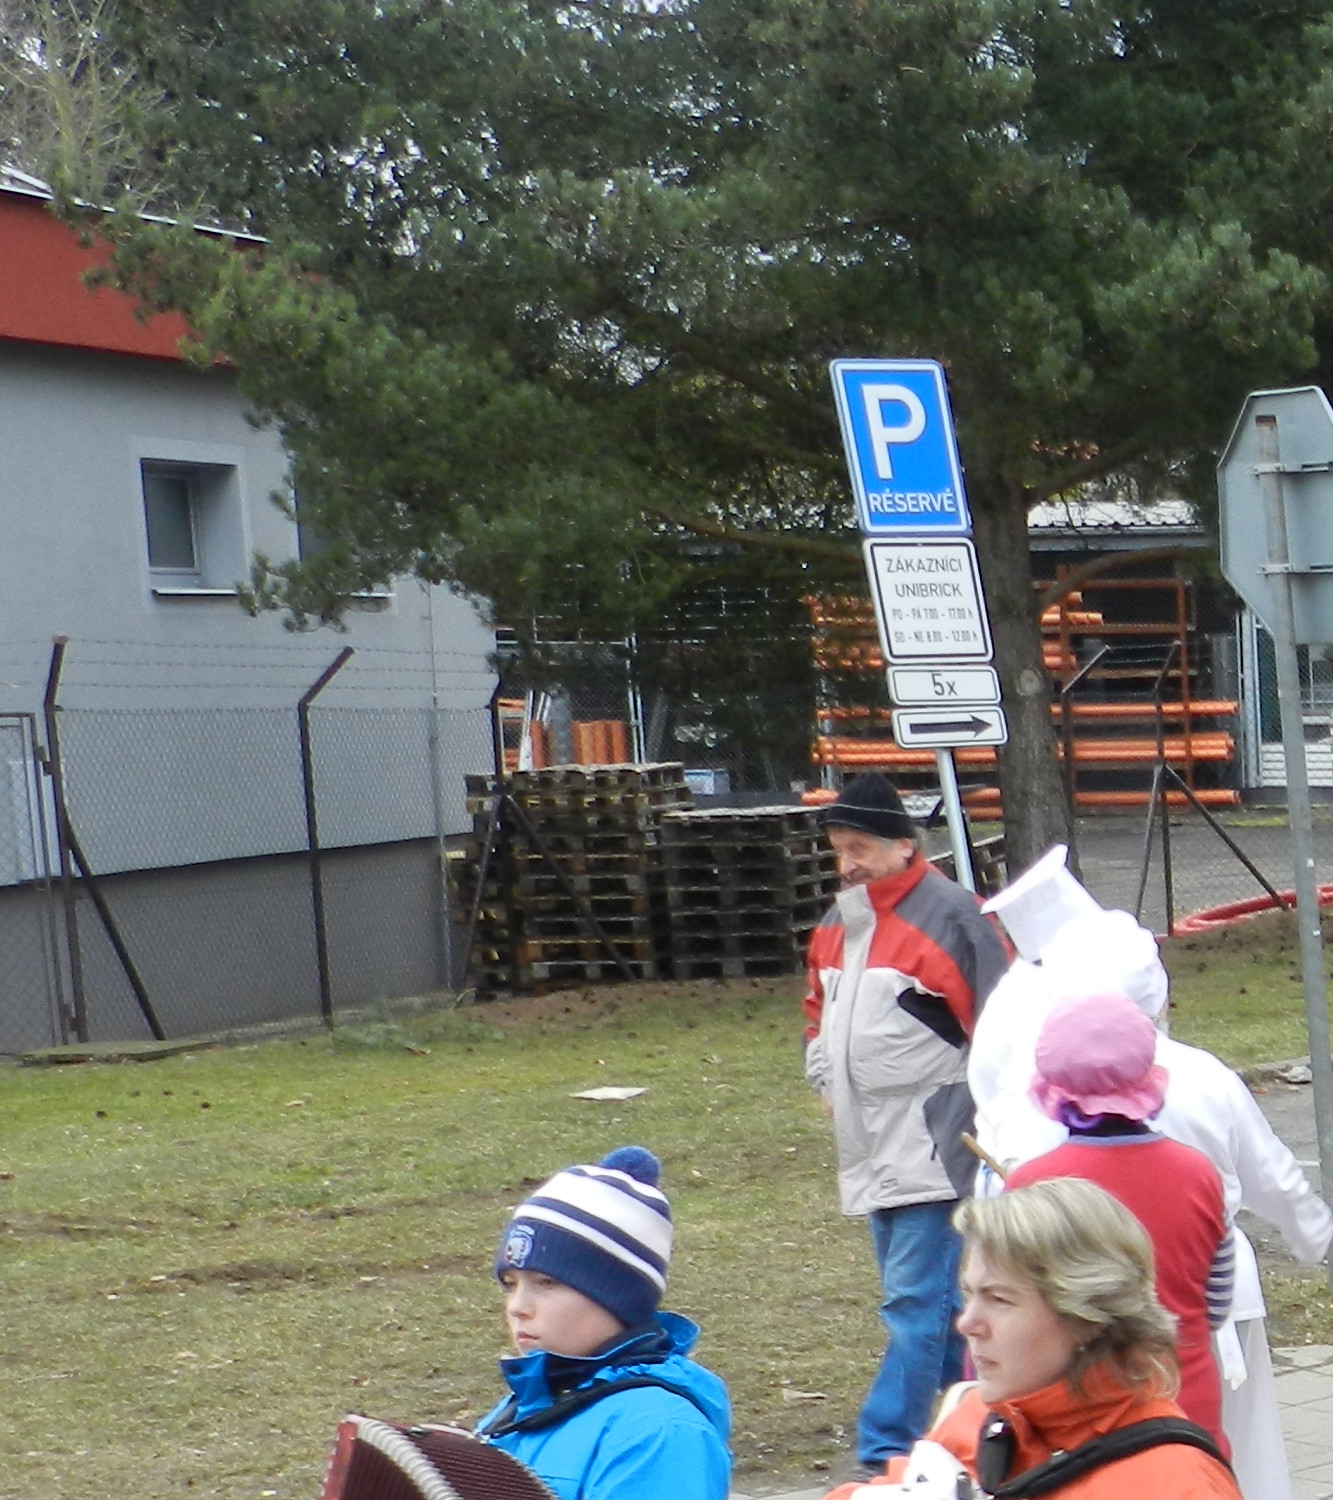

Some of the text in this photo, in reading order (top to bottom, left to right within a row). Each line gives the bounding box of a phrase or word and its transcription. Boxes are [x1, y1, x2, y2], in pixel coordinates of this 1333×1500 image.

[861, 384, 927, 480] P
[885, 555, 963, 573] ZÁKAZNÍCI
[895, 583, 963, 598] UNIBRICK
[932, 673, 958, 696] 5x
